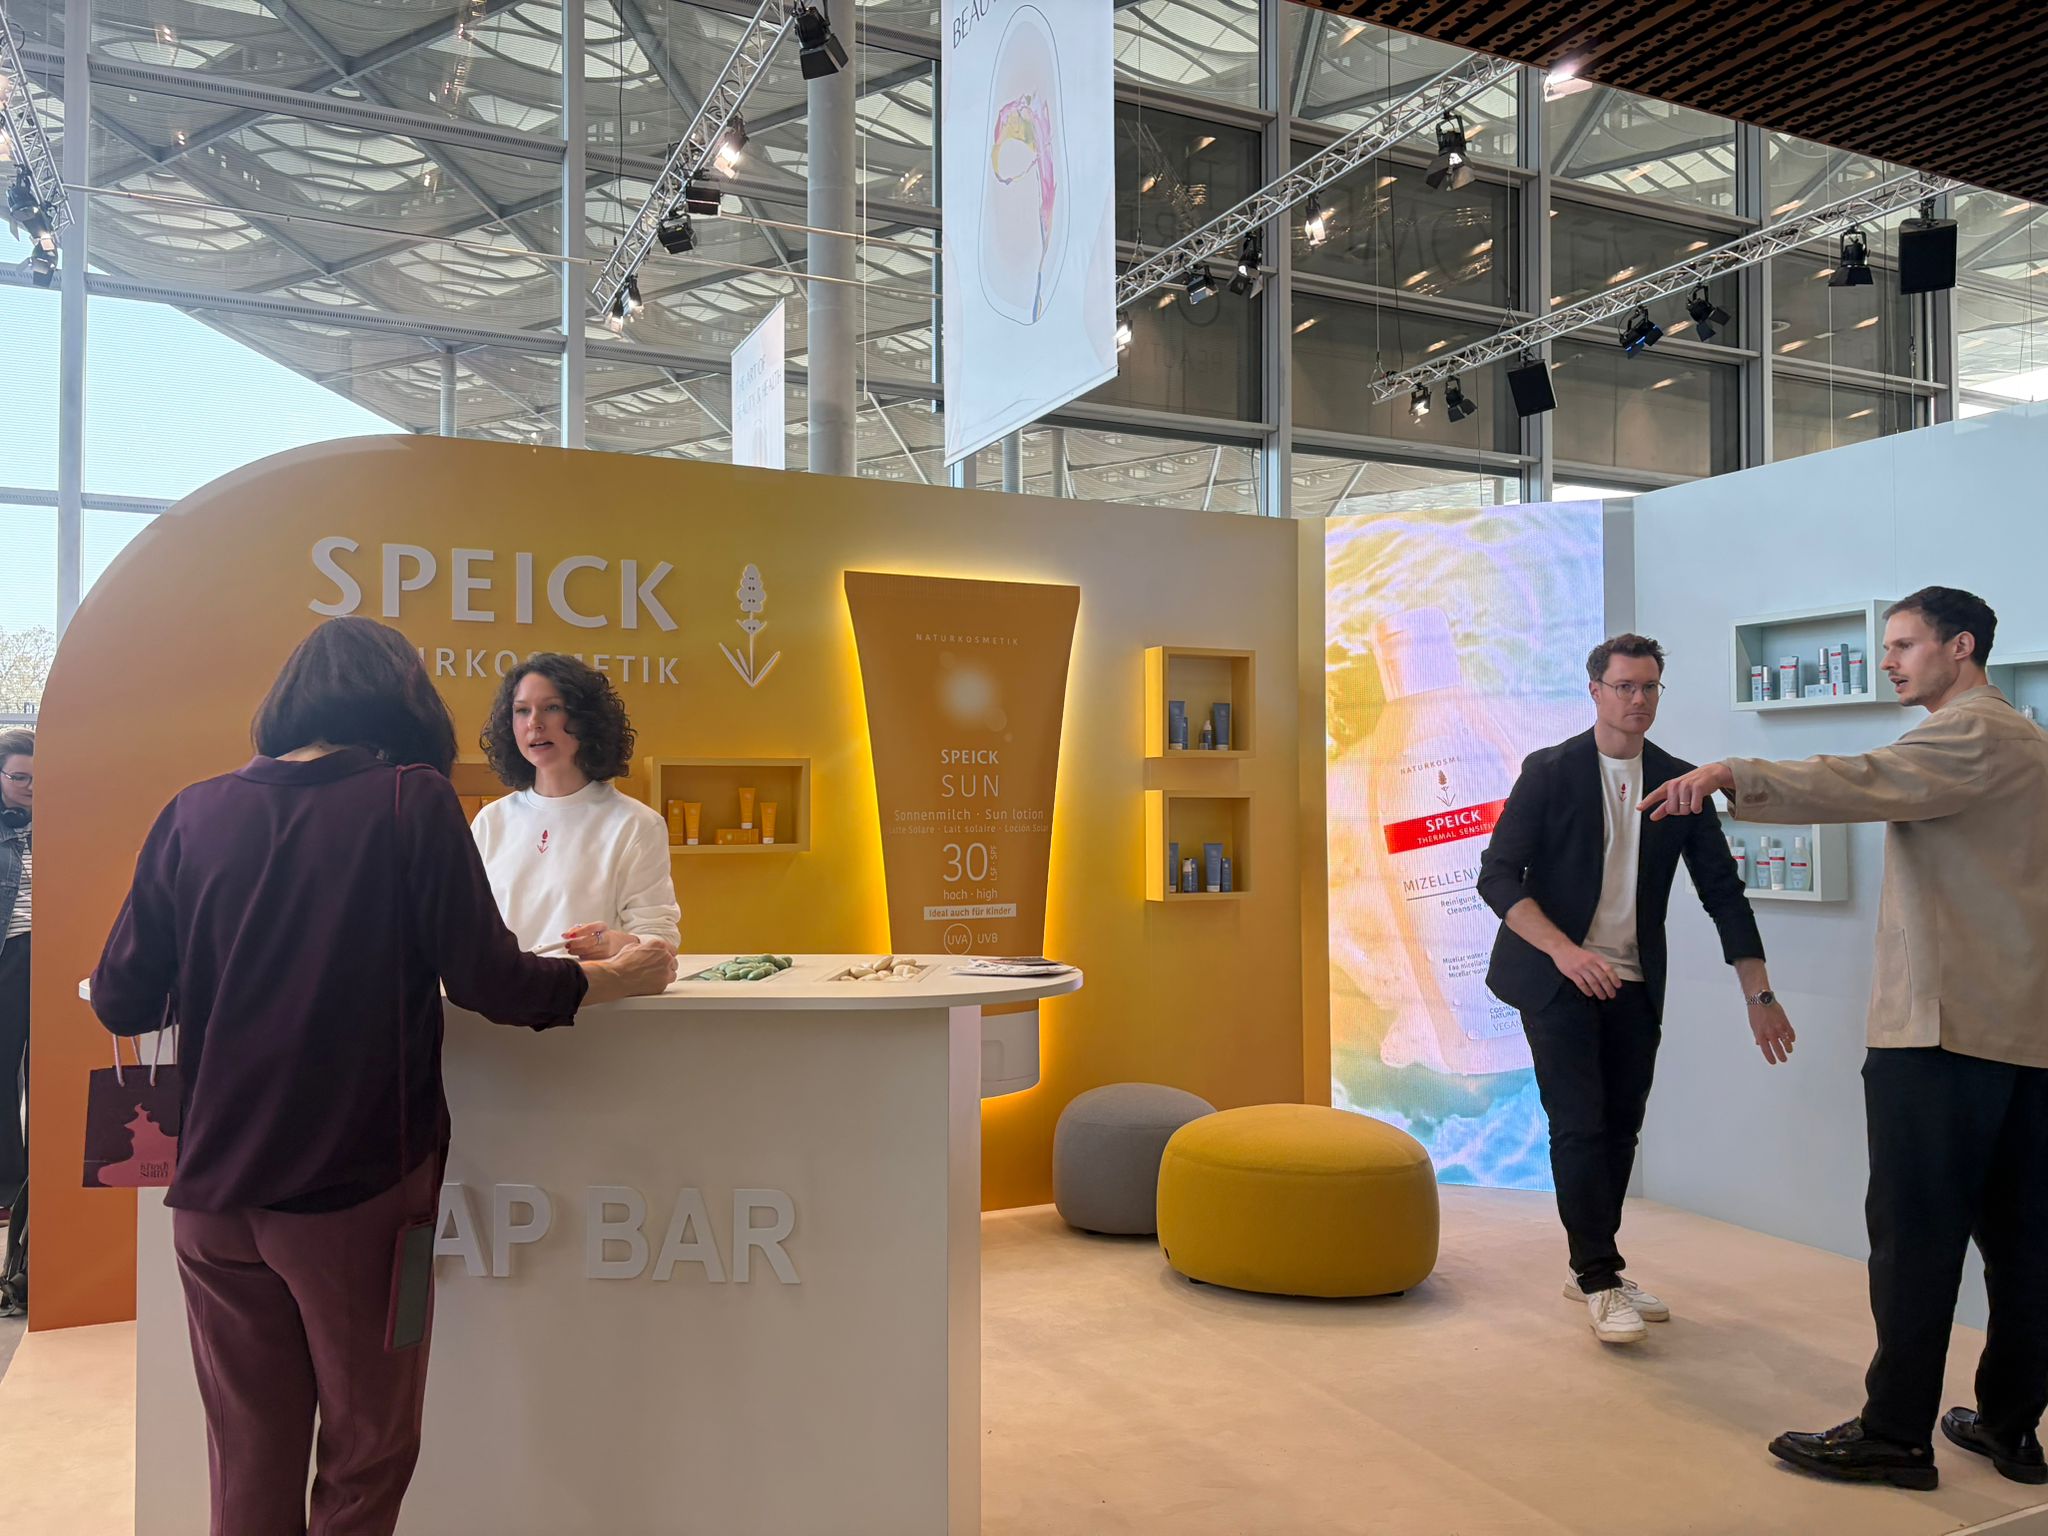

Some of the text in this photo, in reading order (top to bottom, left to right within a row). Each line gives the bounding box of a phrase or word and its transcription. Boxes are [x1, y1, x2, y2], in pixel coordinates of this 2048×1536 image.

[307, 536, 679, 631] SPEICK
[915, 633, 1019, 646] NATURKOSMETIK
[940, 749, 1000, 764] SPEICK
[941, 774, 1000, 798] SUN
[894, 807, 1044, 821] Sonnenmilch Sun lotion
[1425, 809, 1482, 833] SPEICK
[964, 824, 996, 834] solaire
[1416, 831, 1457, 845] THERMAL
[942, 842, 989, 882] 30
[1403, 866, 1480, 893] MIZELLEN
[943, 888, 998, 901] hoch high
[1440, 895, 1477, 908] Reinigung
[929, 905, 1012, 918] Ideal auch für Kinder
[1446, 903, 1483, 915] Cleansing
[947, 932, 998, 945] UVA UVB
[586, 1185, 801, 1285] BAR
